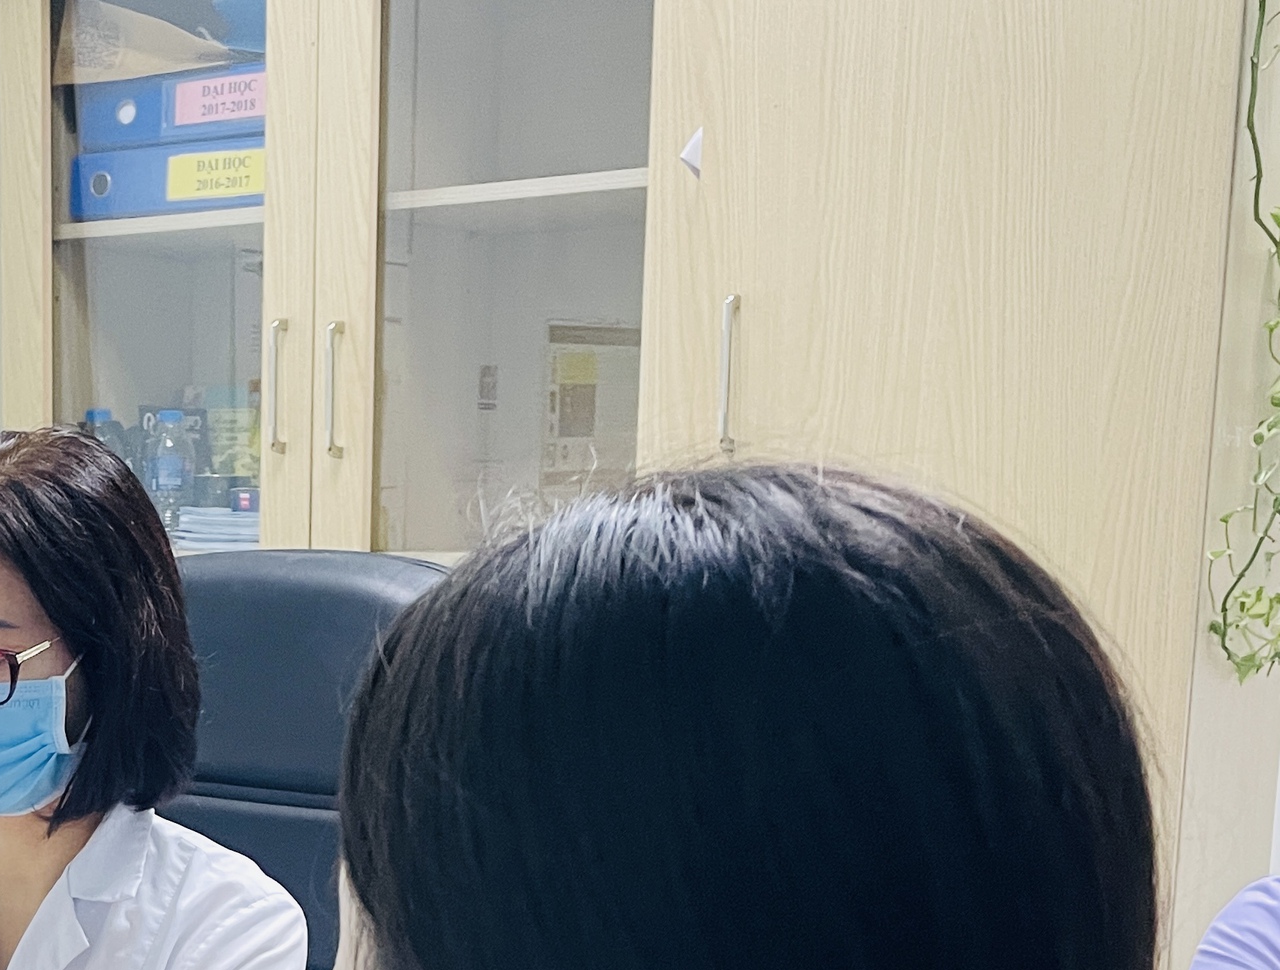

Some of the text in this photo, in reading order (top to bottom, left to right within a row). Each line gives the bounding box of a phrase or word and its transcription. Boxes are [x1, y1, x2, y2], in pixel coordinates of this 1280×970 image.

[202, 79, 258, 99] ĐẠI HỌC
[201, 98, 256, 116] 2017-2018
[197, 156, 252, 175] ĐẠI HỌC
[196, 176, 250, 191] 2016-2017
